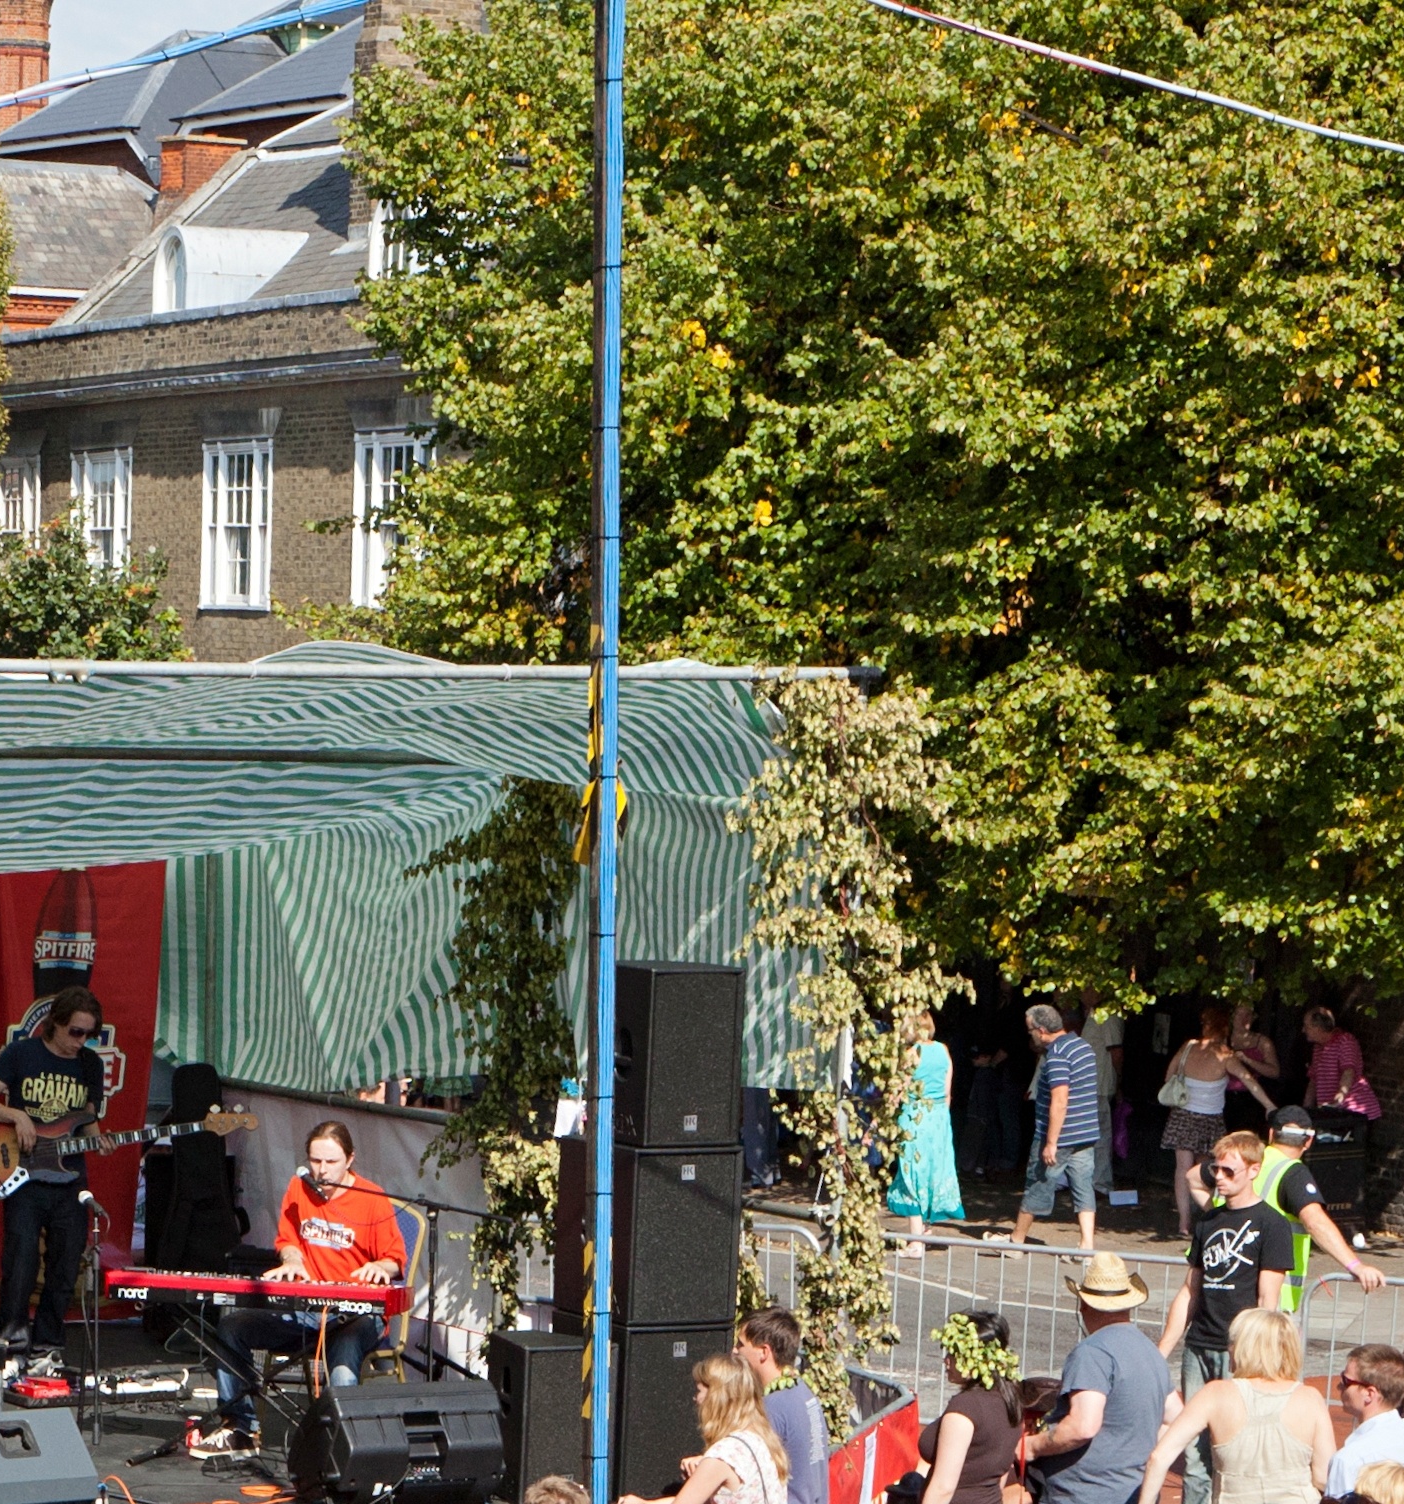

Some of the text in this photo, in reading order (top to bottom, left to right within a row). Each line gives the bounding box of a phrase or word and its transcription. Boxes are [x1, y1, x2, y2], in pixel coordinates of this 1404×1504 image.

[34, 940, 96, 961] SPITFIRE
[24, 1003, 53, 1032] SHEPH
[21, 1077, 89, 1109] GRAHAM
[1326, 1203, 1352, 1211] ITTER
[118, 1287, 148, 1299] nord
[338, 1300, 373, 1315] stage
